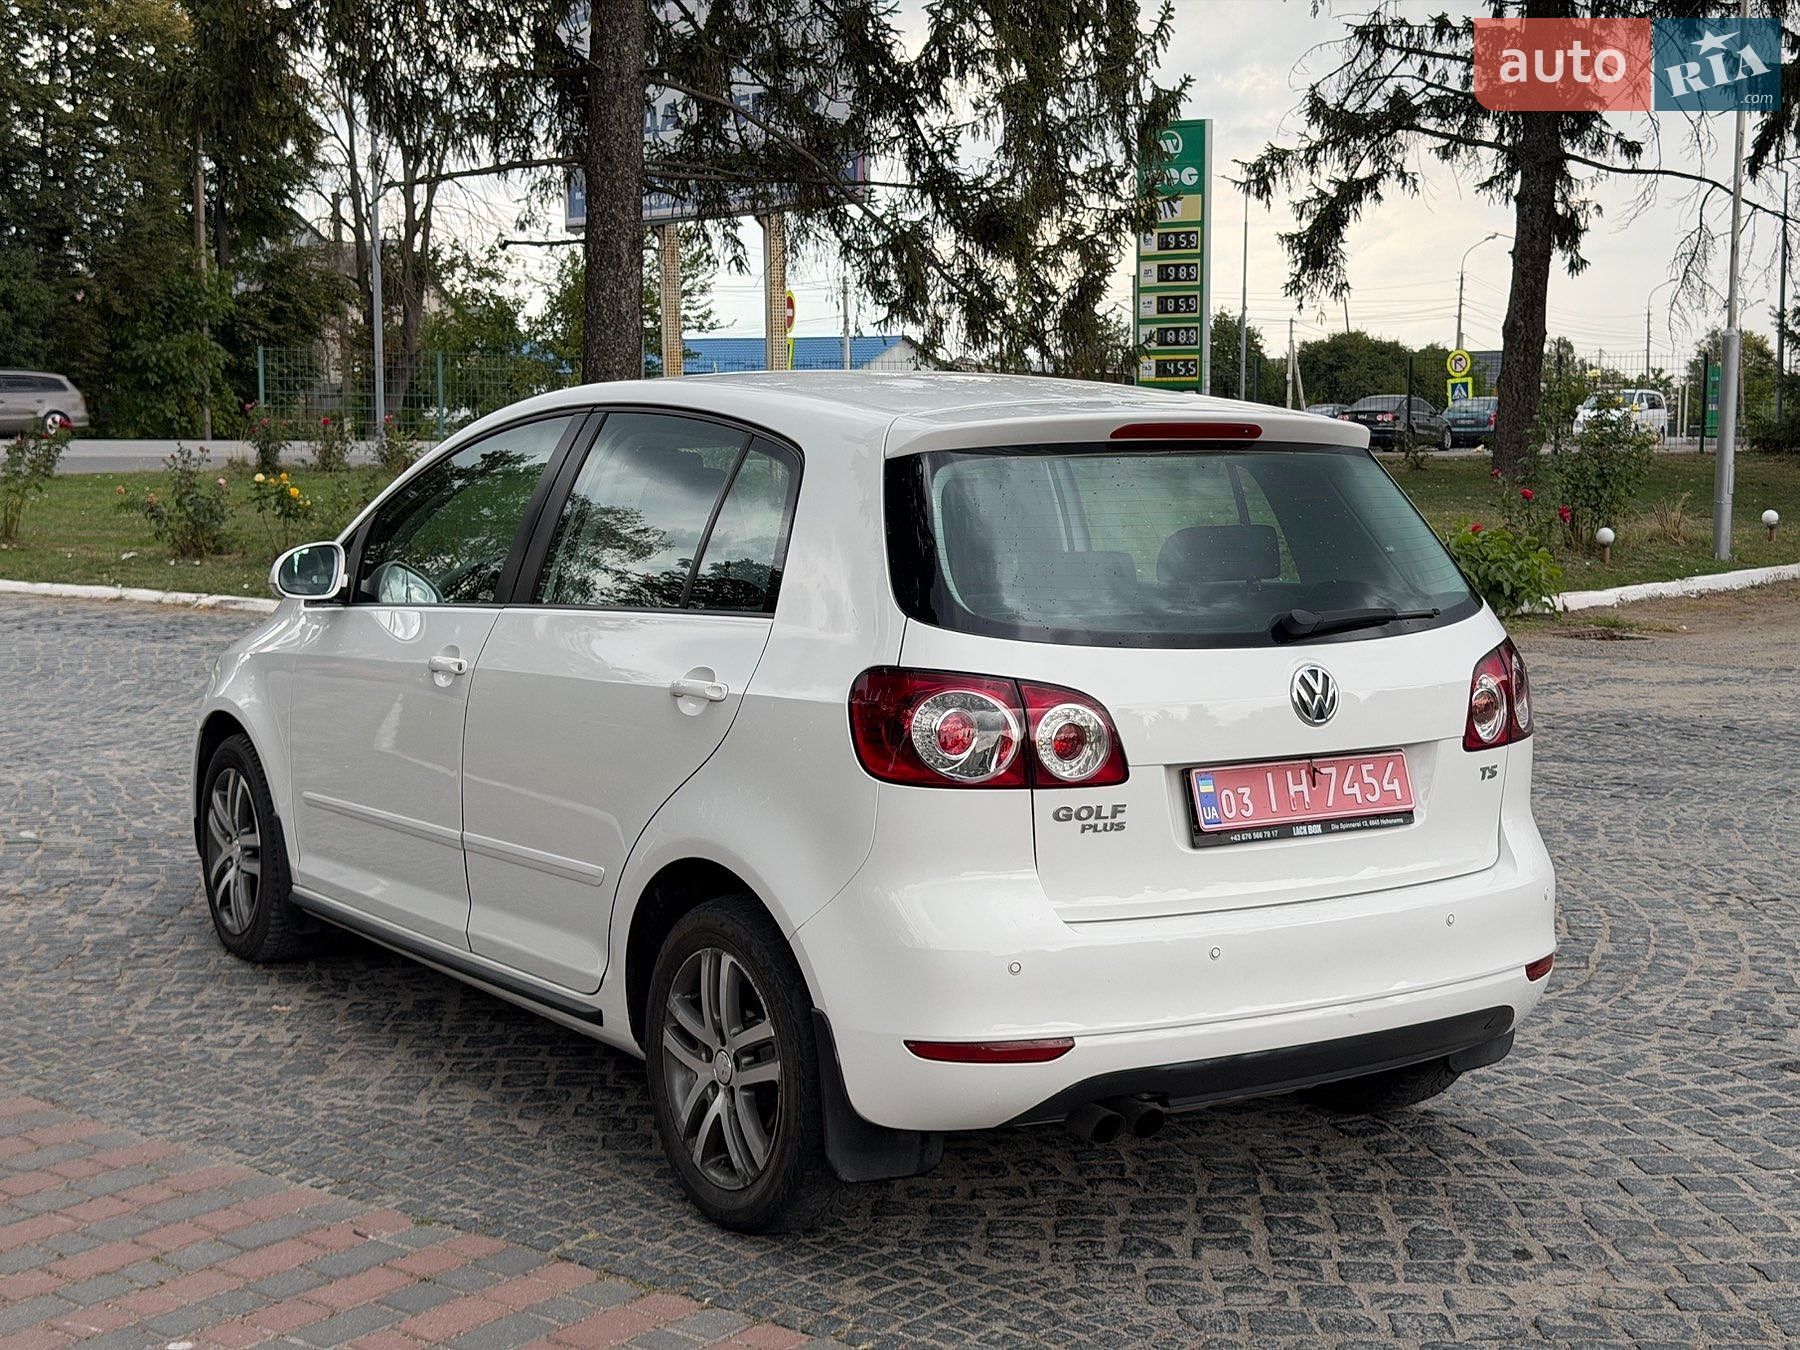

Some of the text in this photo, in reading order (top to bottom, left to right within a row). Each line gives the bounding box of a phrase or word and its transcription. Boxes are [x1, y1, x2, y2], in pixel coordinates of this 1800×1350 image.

[1203, 806, 1220, 821] UA
[1220, 787, 1254, 819] 03
[1319, 760, 1403, 808] 7454
[1052, 804, 1127, 822] GOLF
[1080, 821, 1127, 834] PLUS
[1308, 823, 1323, 835] BOX
